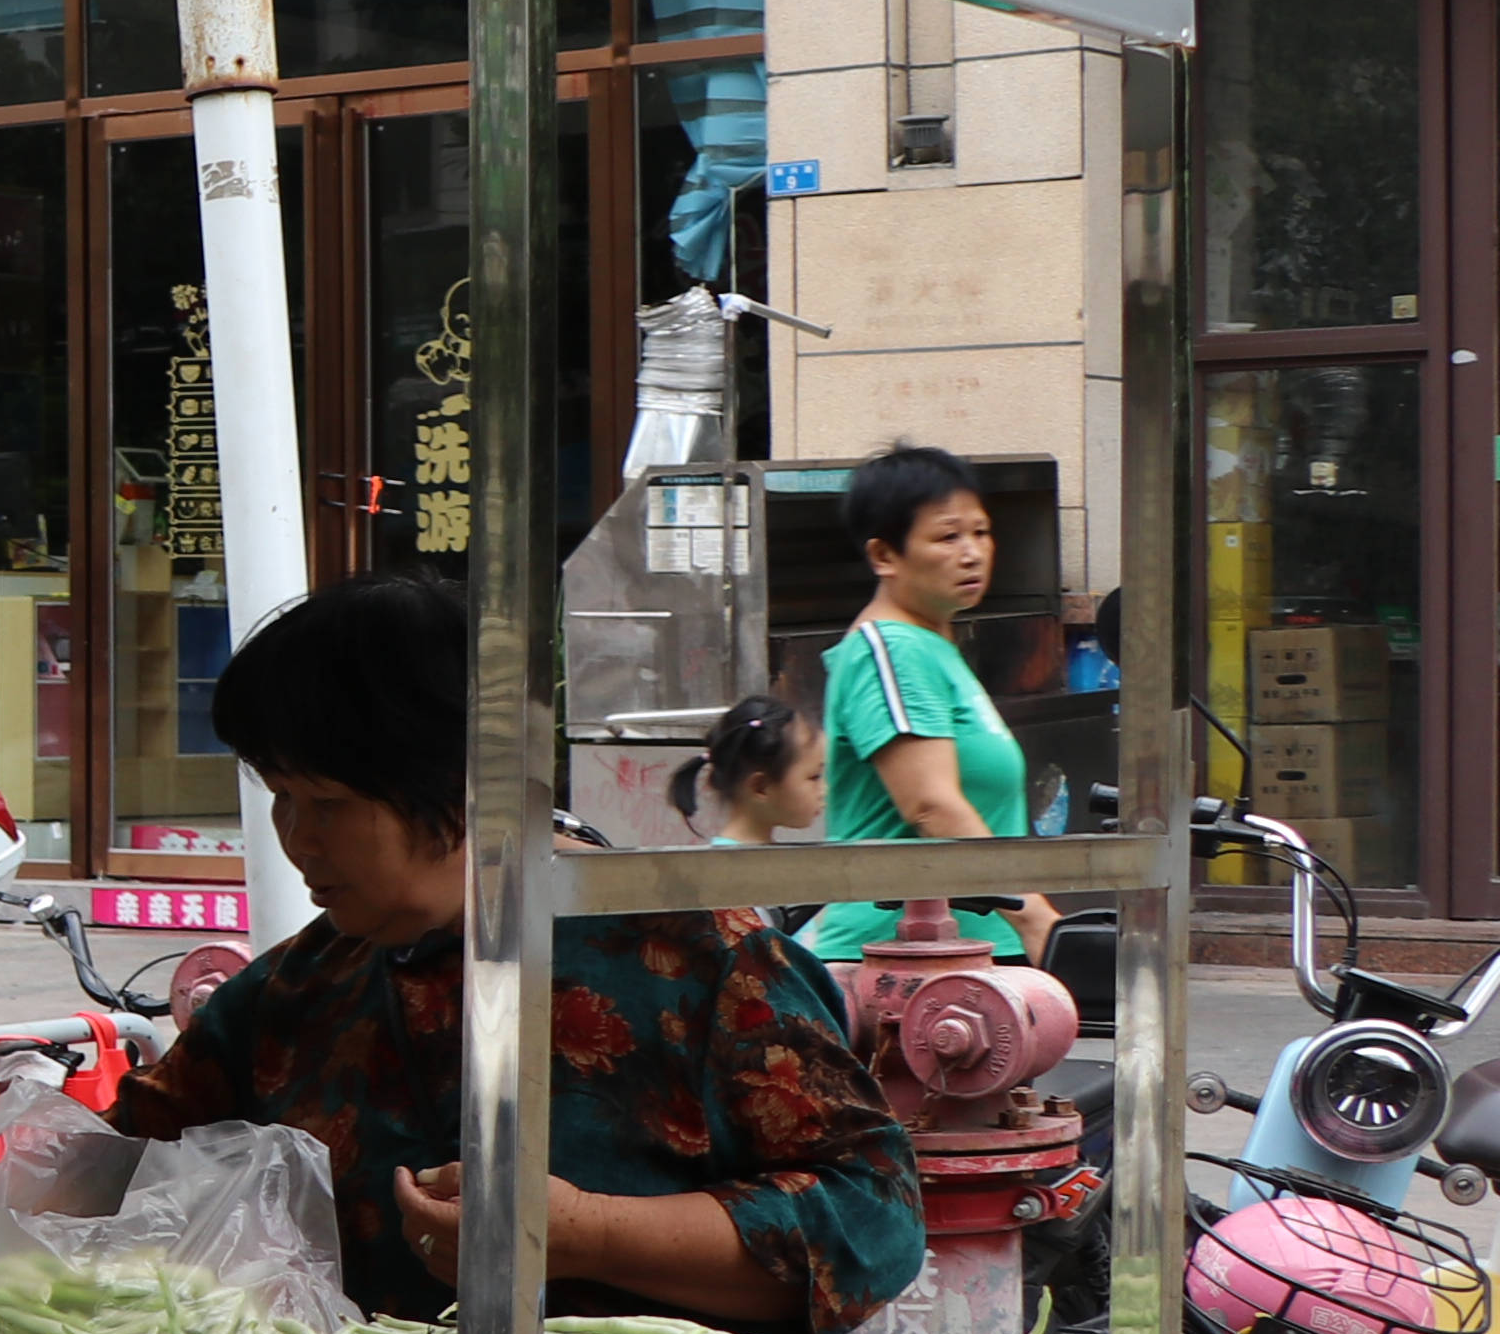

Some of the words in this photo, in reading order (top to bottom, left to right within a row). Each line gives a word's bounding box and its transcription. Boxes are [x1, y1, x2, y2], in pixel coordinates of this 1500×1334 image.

[786, 175, 797, 189] 9
[116, 892, 239, 928] 亲亲天使
